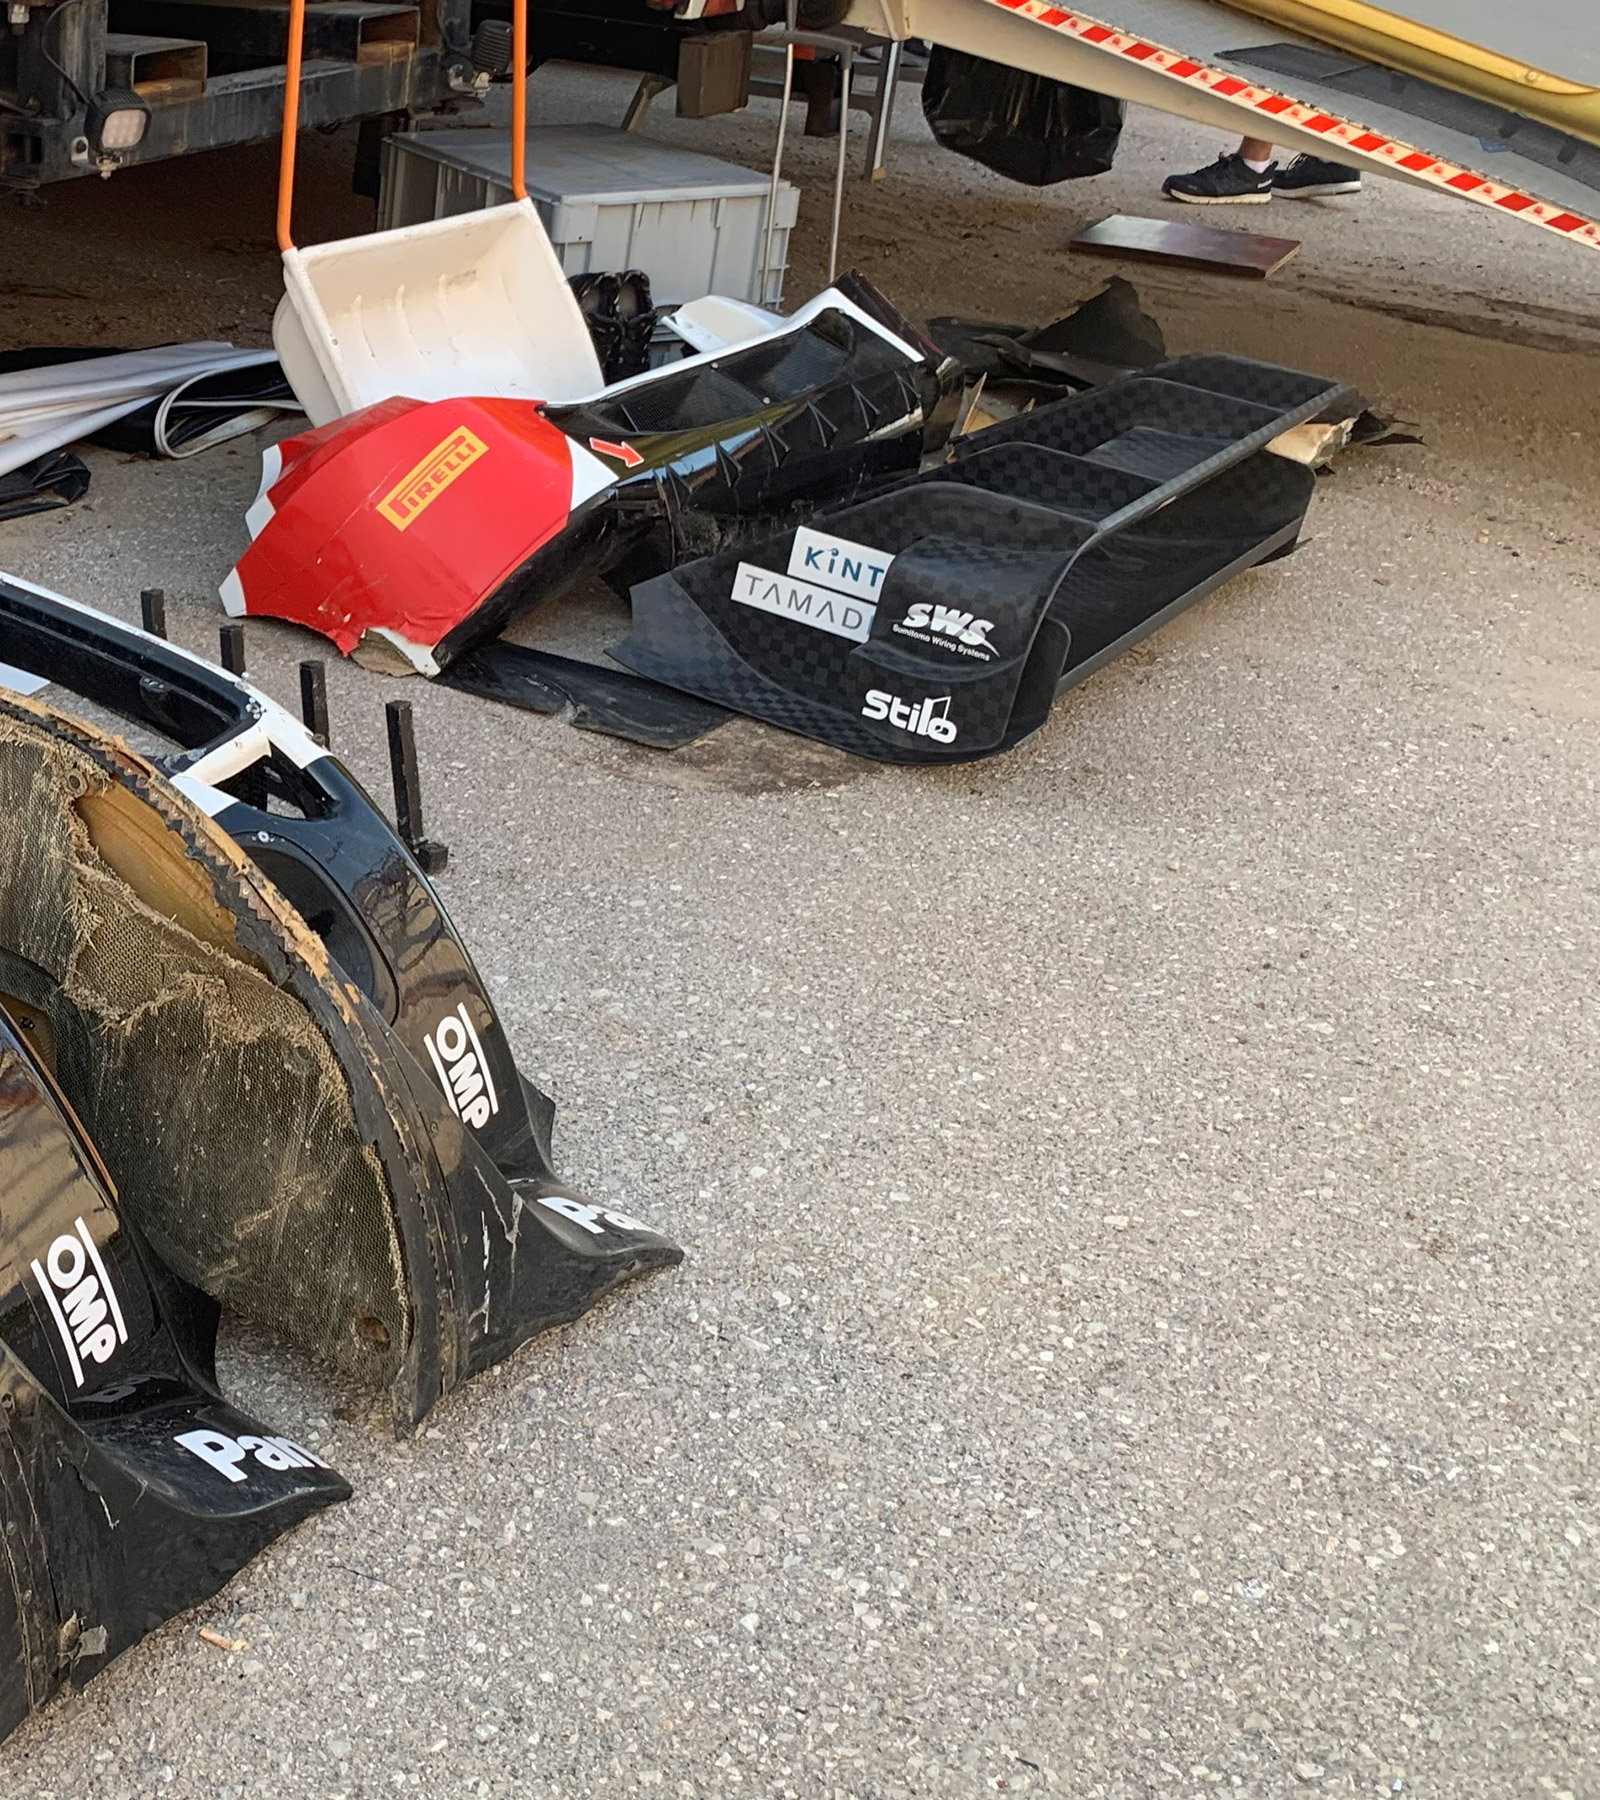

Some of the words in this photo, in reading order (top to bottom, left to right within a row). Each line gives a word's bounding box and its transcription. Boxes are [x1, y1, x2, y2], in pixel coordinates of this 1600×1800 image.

[388, 435, 477, 519] PIRELLI
[745, 573, 875, 635] TAMAD
[902, 603, 998, 653] SWS
[892, 623, 931, 643] Sumitomo
[931, 635, 957, 652] Wiring
[957, 644, 991, 662] Systems
[861, 689, 957, 744] Stilo
[436, 1015, 490, 1129] OMP
[536, 1196, 662, 1235] Pa
[47, 1234, 117, 1364] OMP
